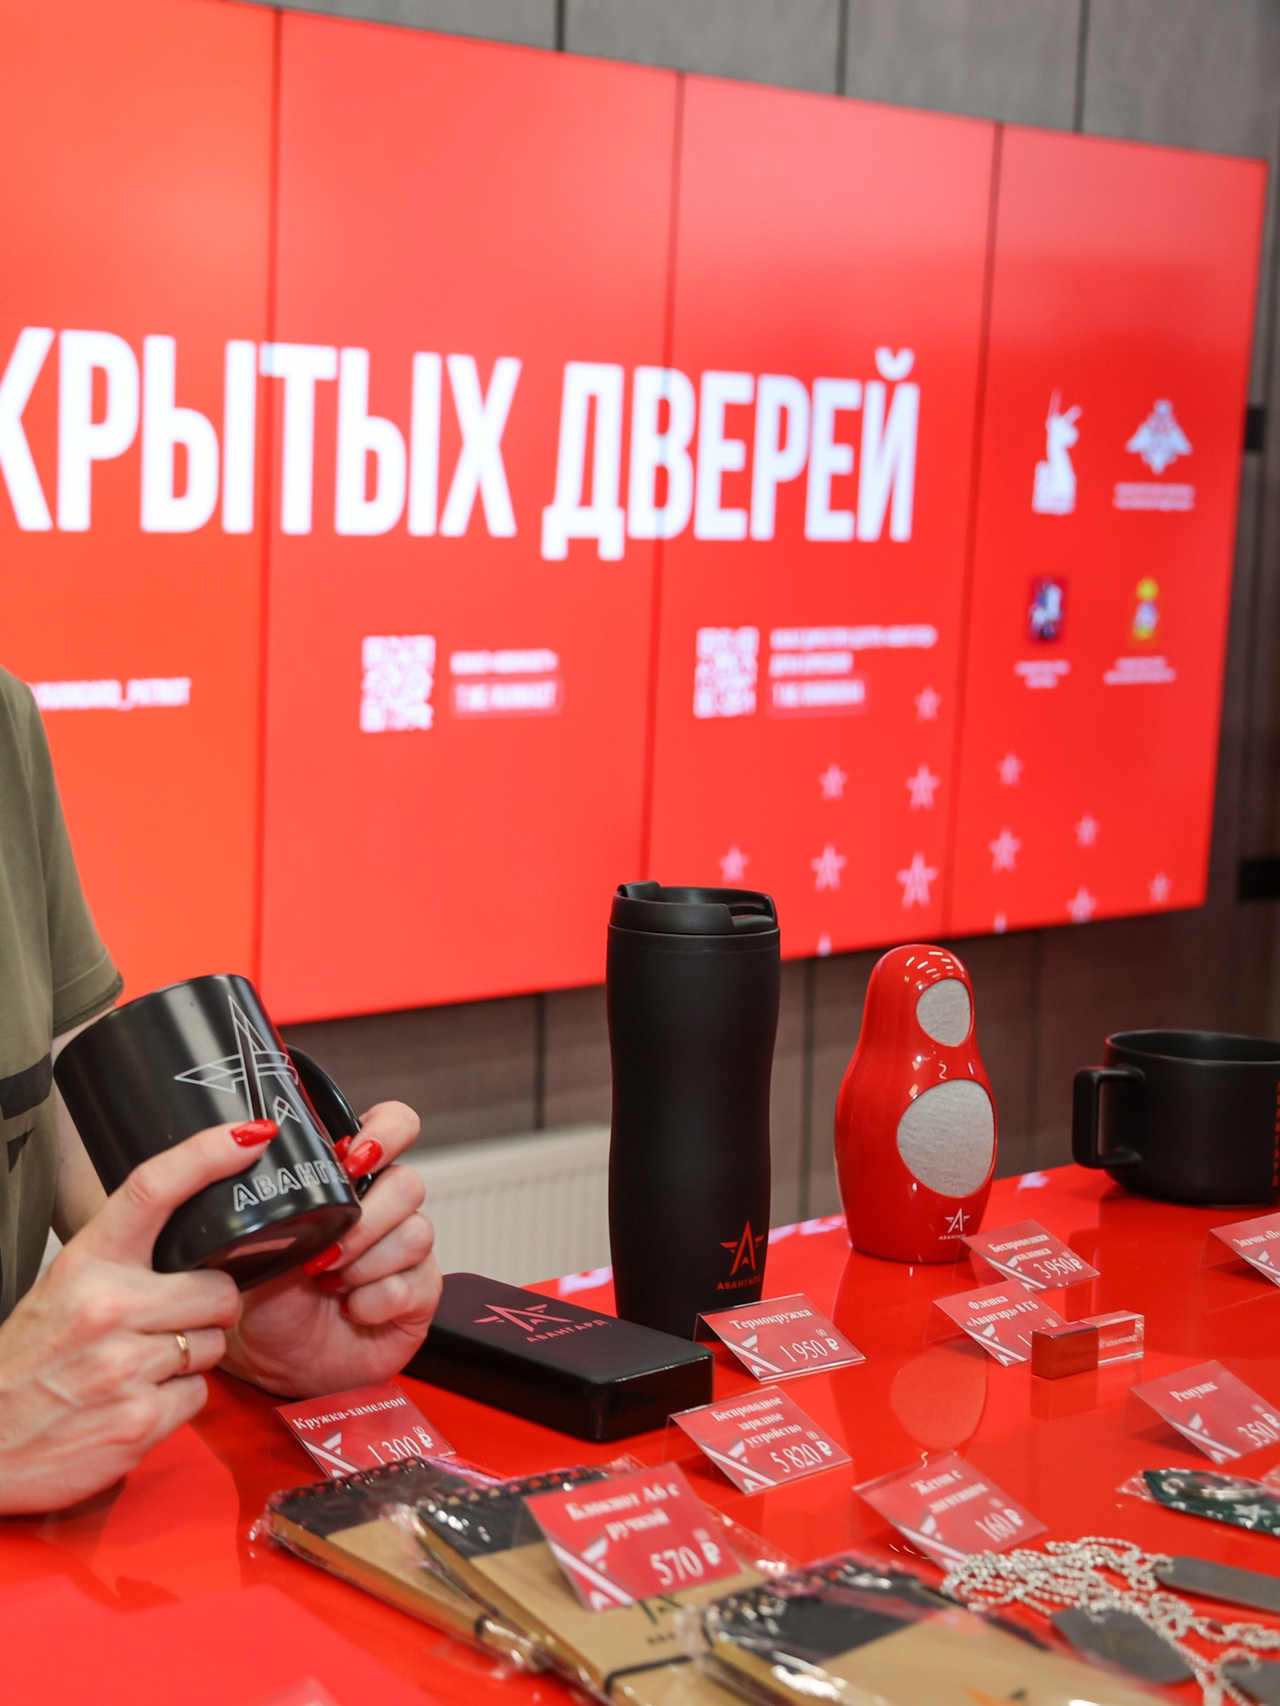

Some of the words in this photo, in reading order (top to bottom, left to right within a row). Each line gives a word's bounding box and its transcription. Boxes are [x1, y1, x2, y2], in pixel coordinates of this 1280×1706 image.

[541, 346, 920, 560] ДВЕРЕЙ
[988, 1233, 1050, 1253] Беспроводная
[968, 1295, 1009, 1310] Флешка
[526, 1319, 609, 1342] АВАНГАРД
[730, 1308, 813, 1330] Термокружка
[292, 1397, 407, 1430] Кружка-хамелеон
[711, 1396, 783, 1422] Беспроводное
[737, 1412, 784, 1431] зарядное
[744, 1423, 802, 1448] устройство
[565, 1493, 641, 1521] Блокнот
[649, 1546, 704, 1586] 570
